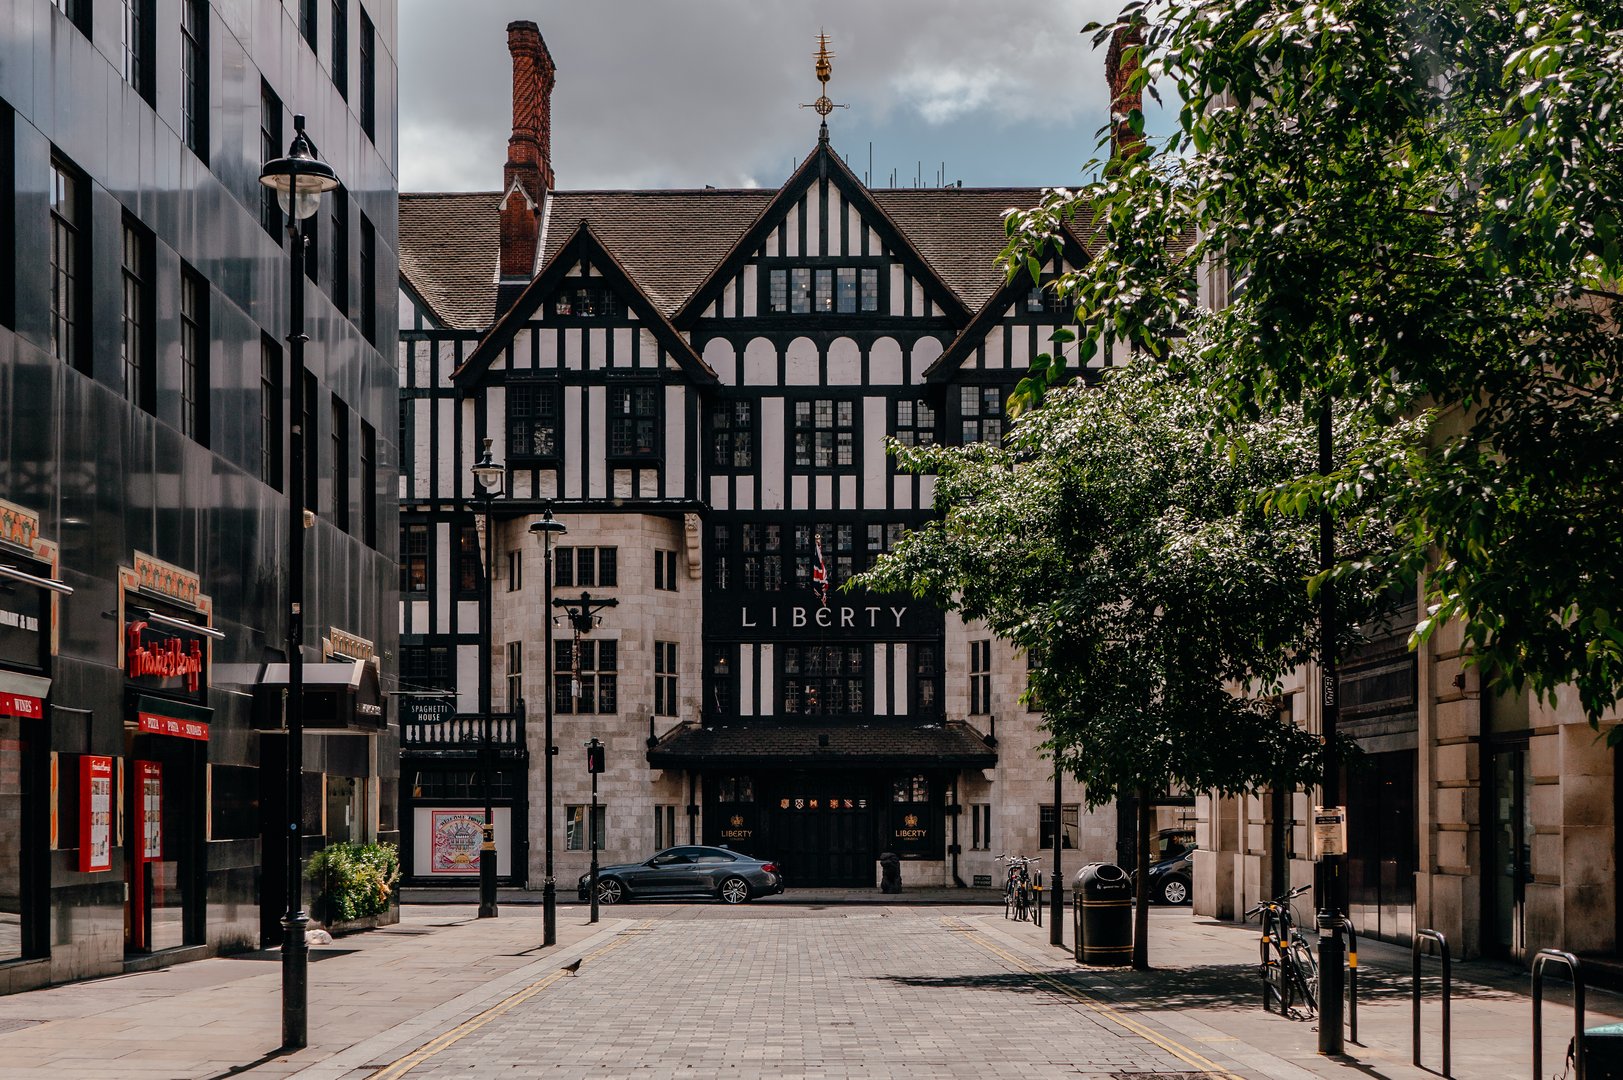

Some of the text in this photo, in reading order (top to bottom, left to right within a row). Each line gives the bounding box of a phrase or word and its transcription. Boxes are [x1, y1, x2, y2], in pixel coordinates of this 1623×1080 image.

[742, 607, 907, 627] LIBERTY
[14, 698, 32, 713] WINES
[411, 705, 448, 713] SPAGHETTI
[418, 713, 440, 721] HOUSE
[721, 830, 753, 838] LIBERTY
[895, 829, 927, 837] LIBERTY
